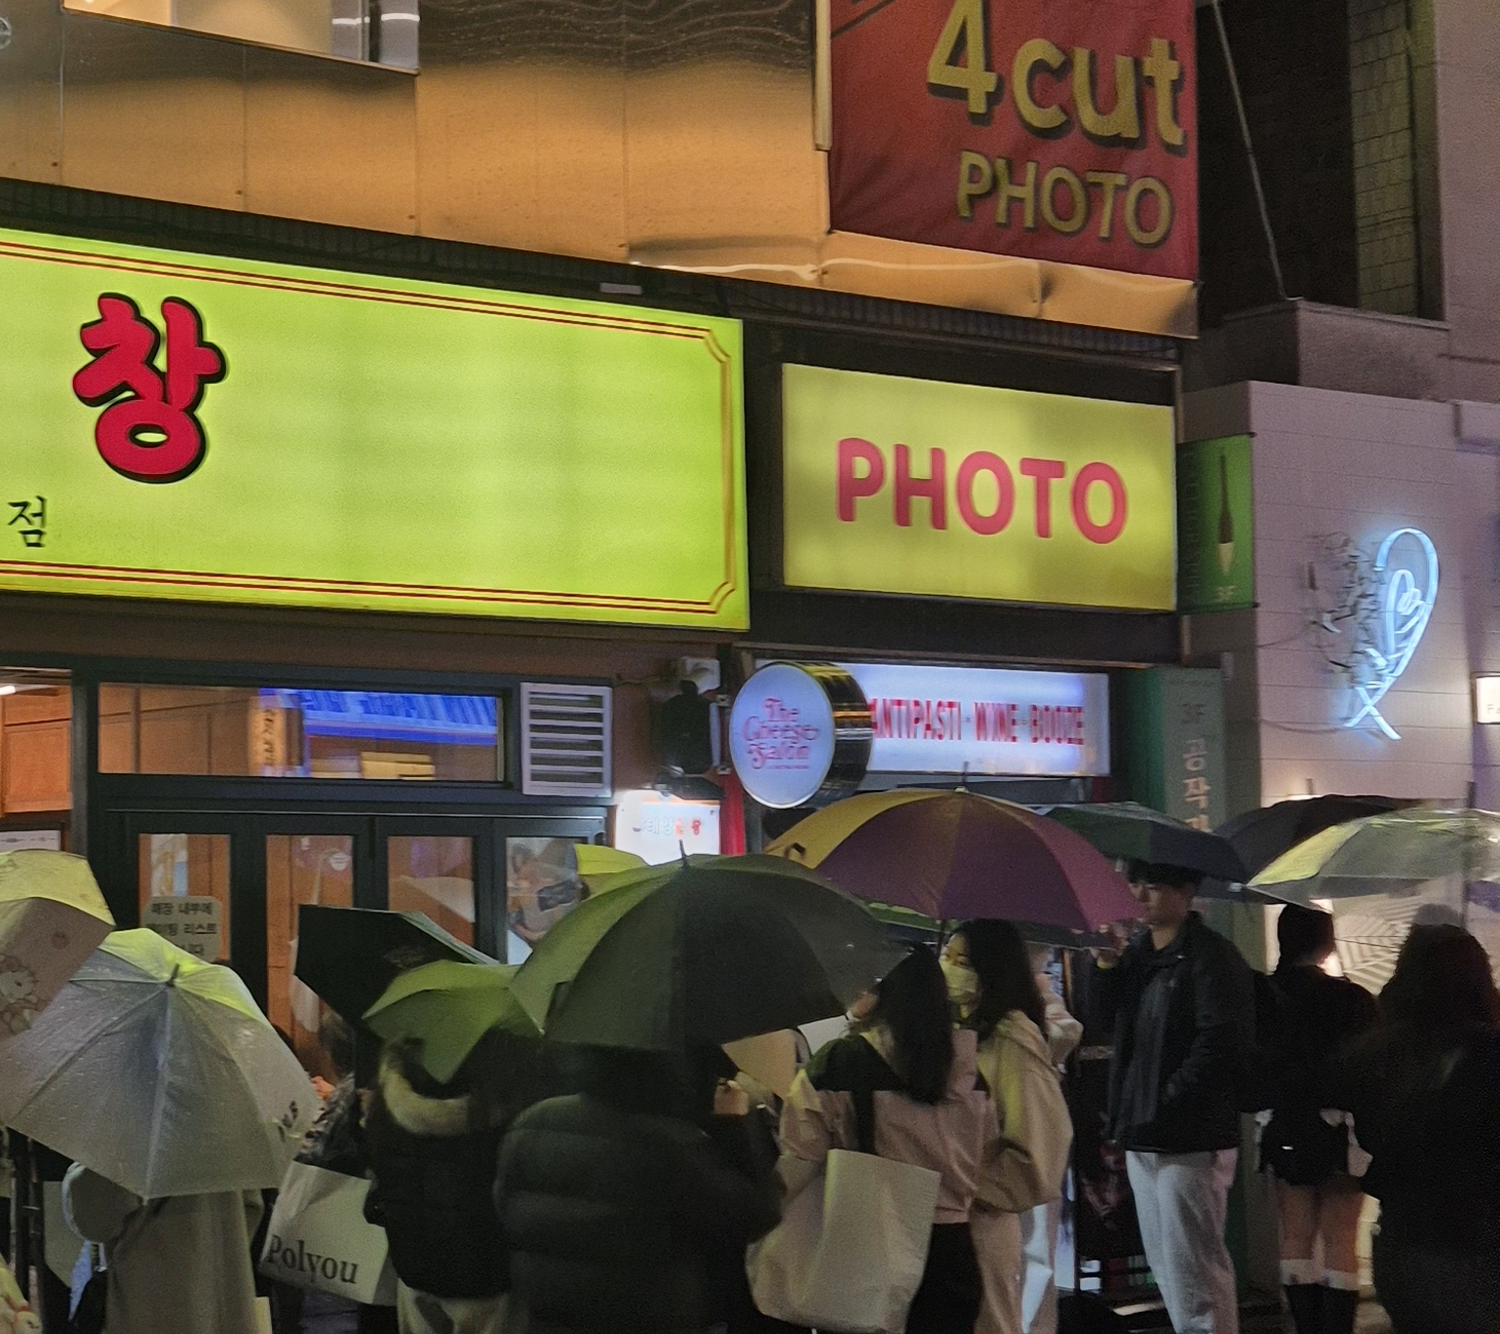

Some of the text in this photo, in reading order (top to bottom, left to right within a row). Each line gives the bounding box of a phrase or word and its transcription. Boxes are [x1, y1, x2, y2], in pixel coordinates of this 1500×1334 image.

[956, 151, 1175, 247] PHOTO
[835, 436, 1128, 545] PHOTO
[764, 697, 800, 722] The
[869, 698, 962, 741] ANTIPASTI
